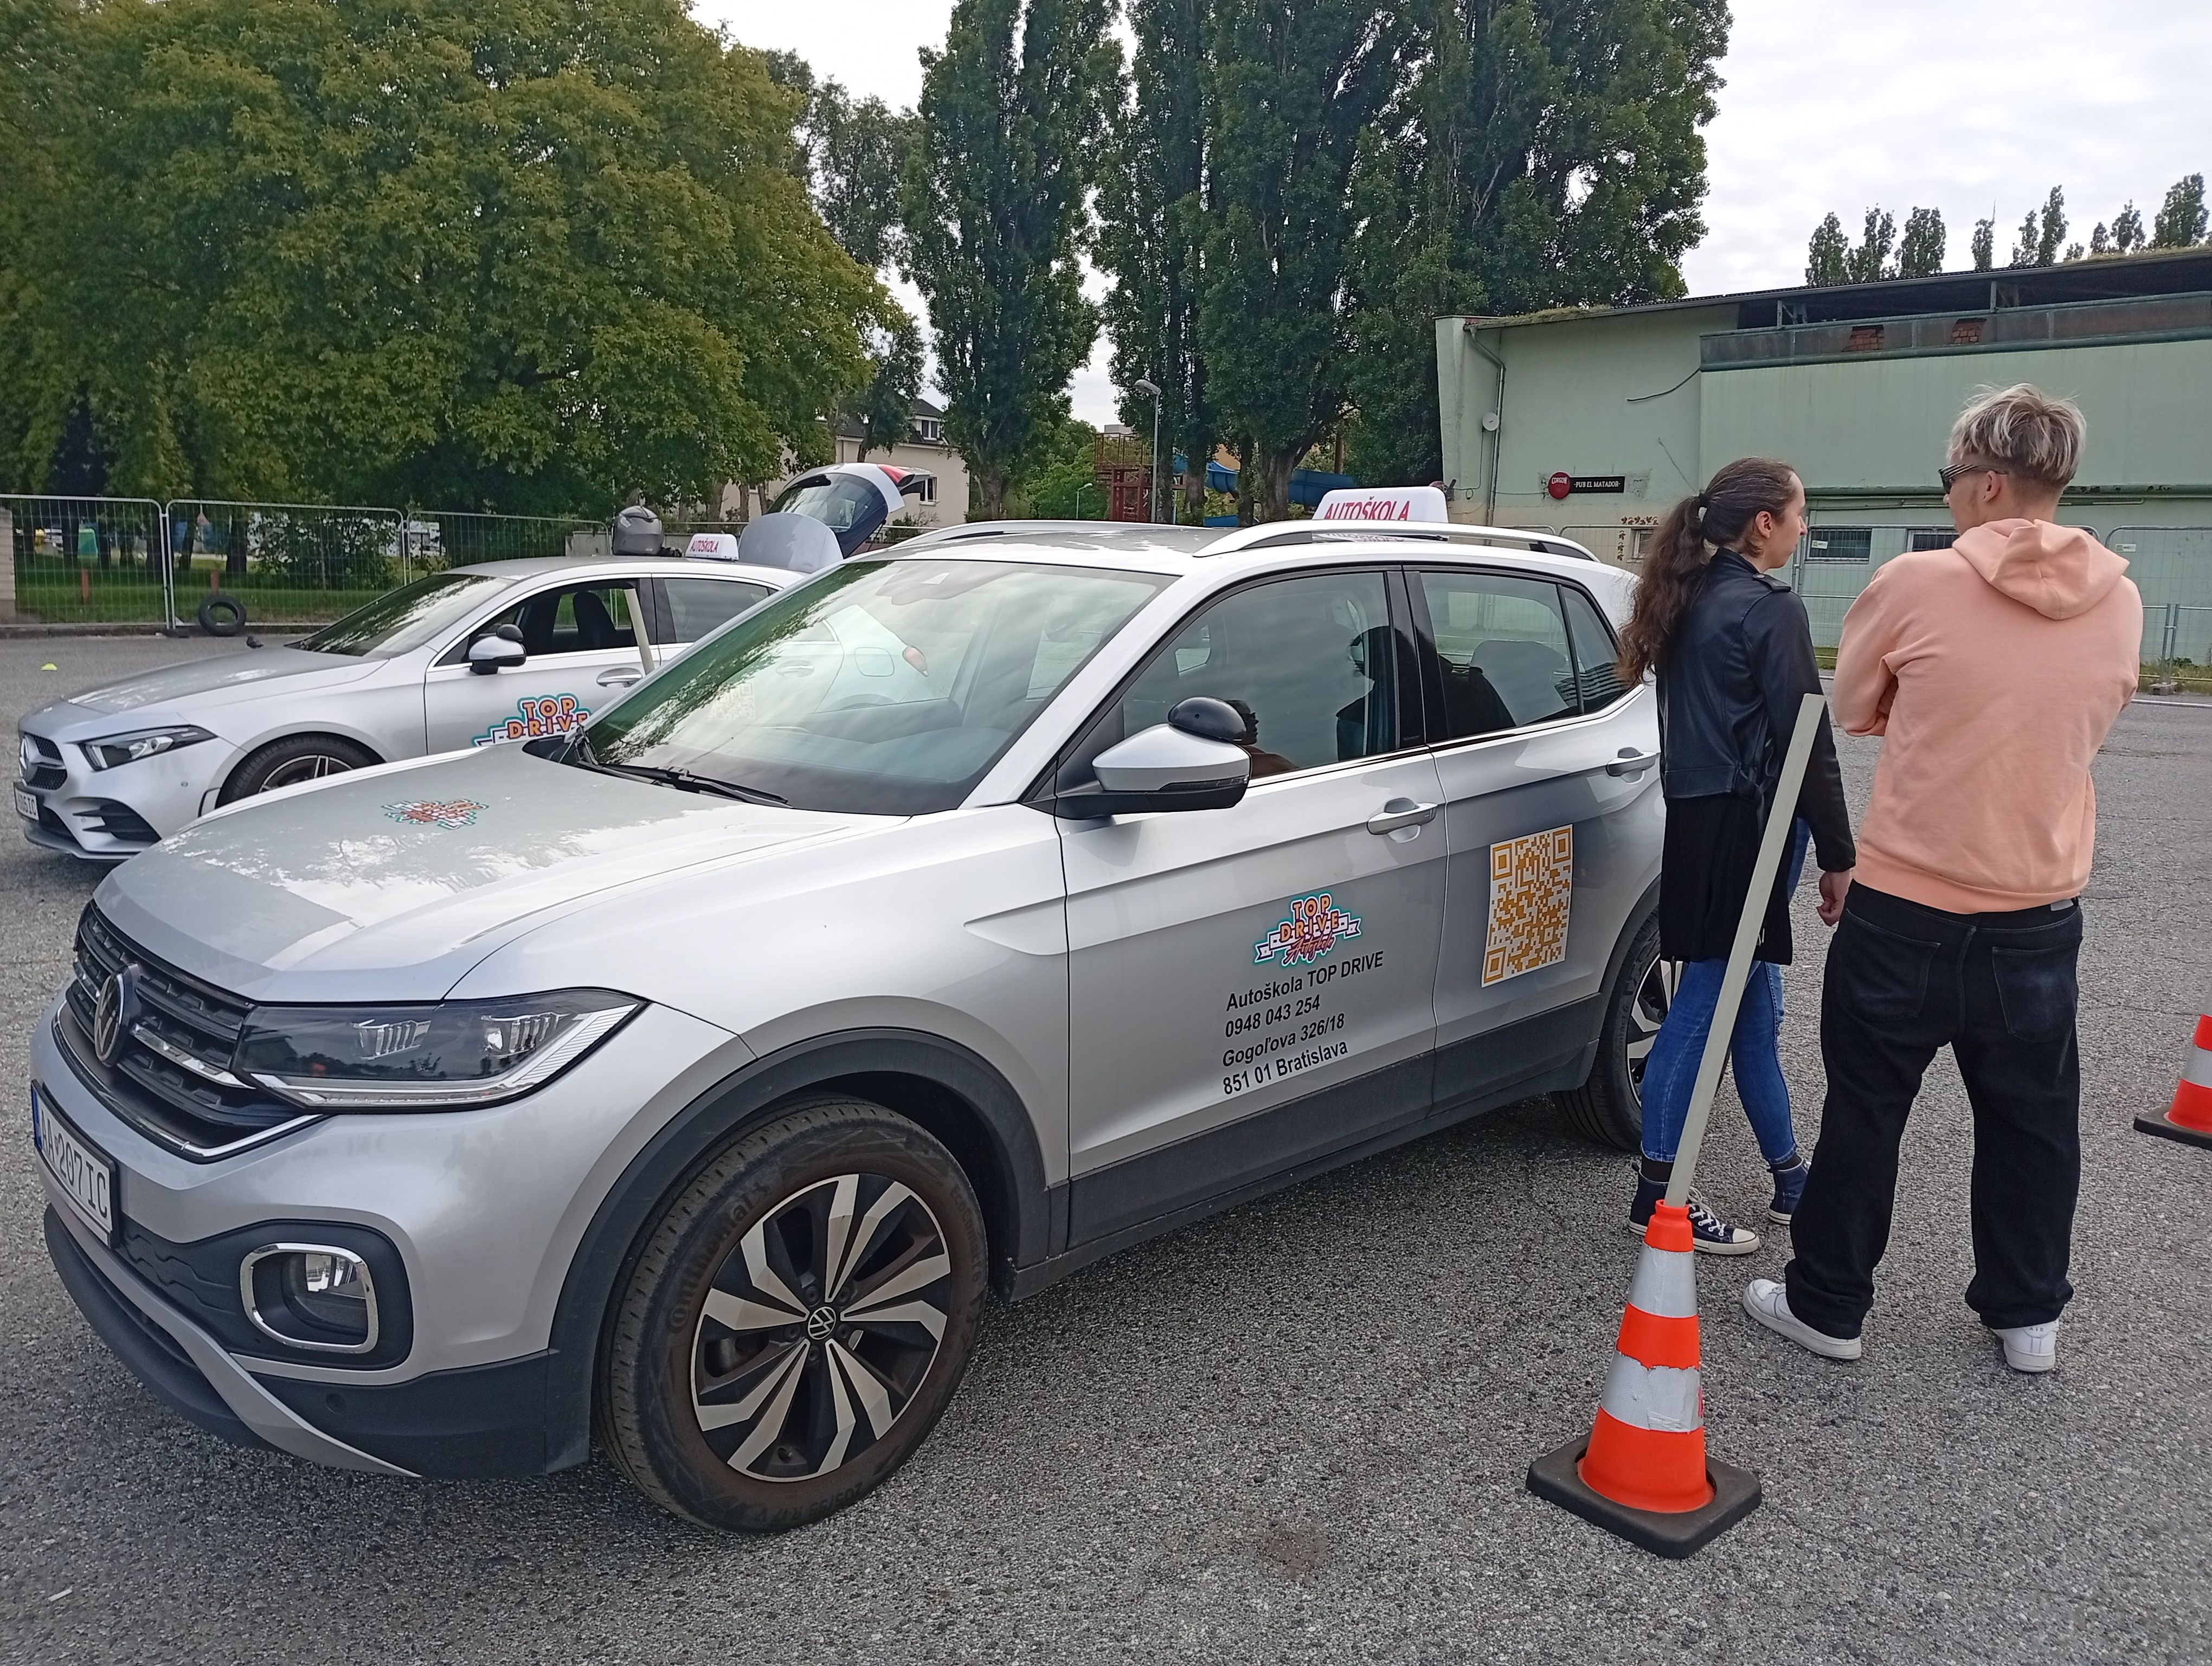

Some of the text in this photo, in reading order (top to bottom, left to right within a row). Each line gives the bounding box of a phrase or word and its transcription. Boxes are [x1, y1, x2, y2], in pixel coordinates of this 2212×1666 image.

[1323, 496, 1410, 521] AUTOŠKOLA
[522, 697, 575, 720] TOP
[1293, 895, 1330, 921] TOP
[1280, 911, 1339, 943] DRIVE
[1226, 951, 1384, 1011] Autoškola TOP DRIVE
[1225, 994, 1320, 1037] 0948 043 254
[1222, 1013, 1345, 1067] Gogoľova 326/18
[1223, 1040, 1348, 1095] 851 01 Bratislava
